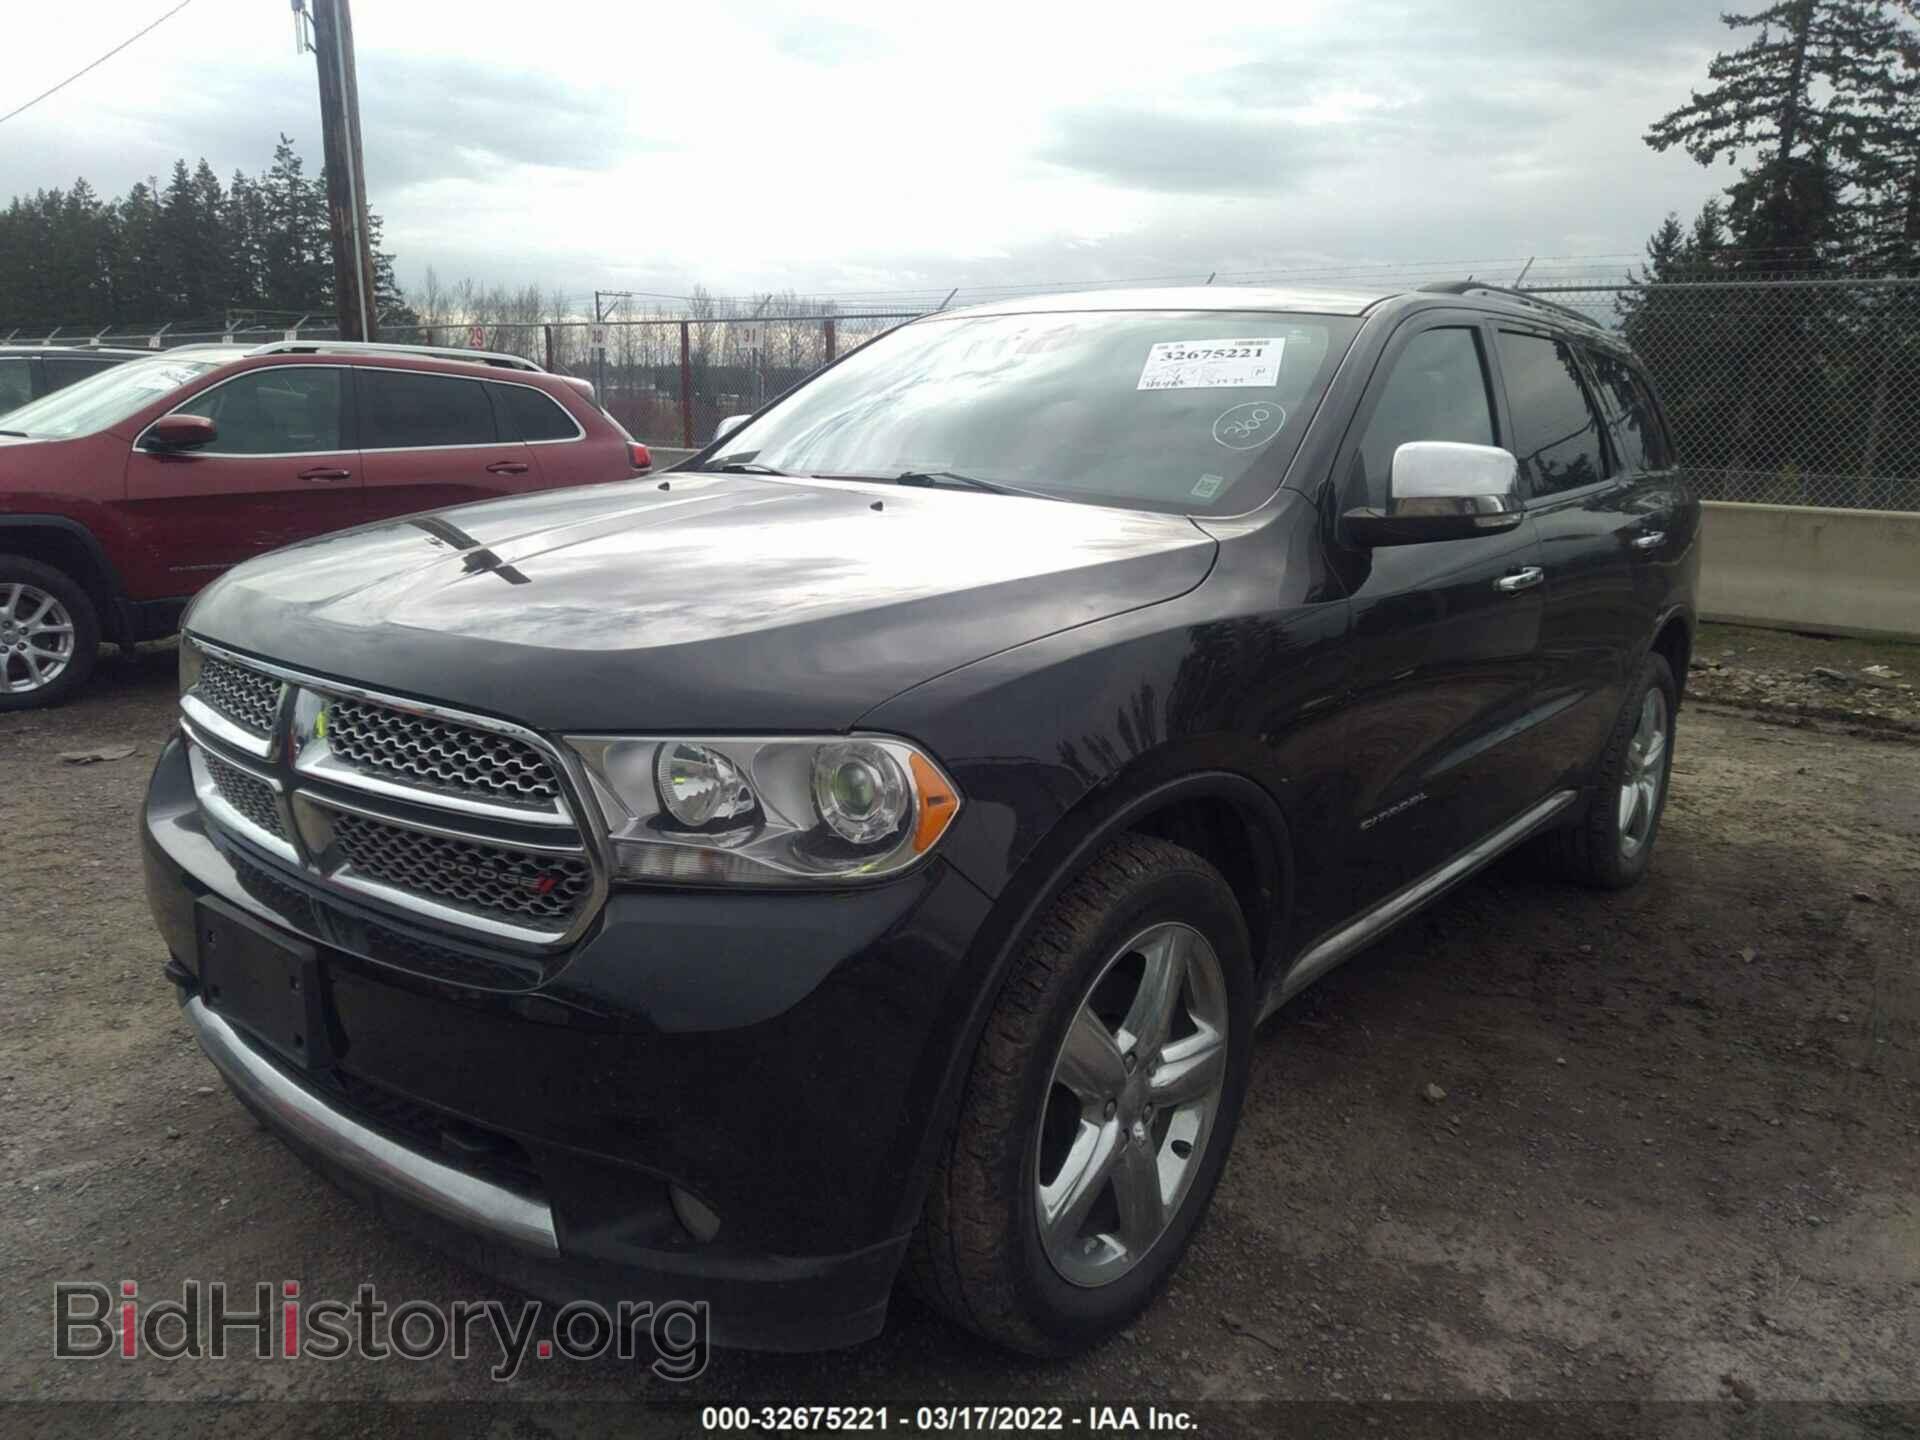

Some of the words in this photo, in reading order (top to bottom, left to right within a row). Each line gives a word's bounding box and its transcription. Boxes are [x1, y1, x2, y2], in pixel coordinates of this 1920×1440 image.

[469, 327, 483, 346] 29
[1159, 348, 1264, 361] 32675221
[1223, 409, 1270, 439] 360
[439, 859, 541, 888] DODGE
